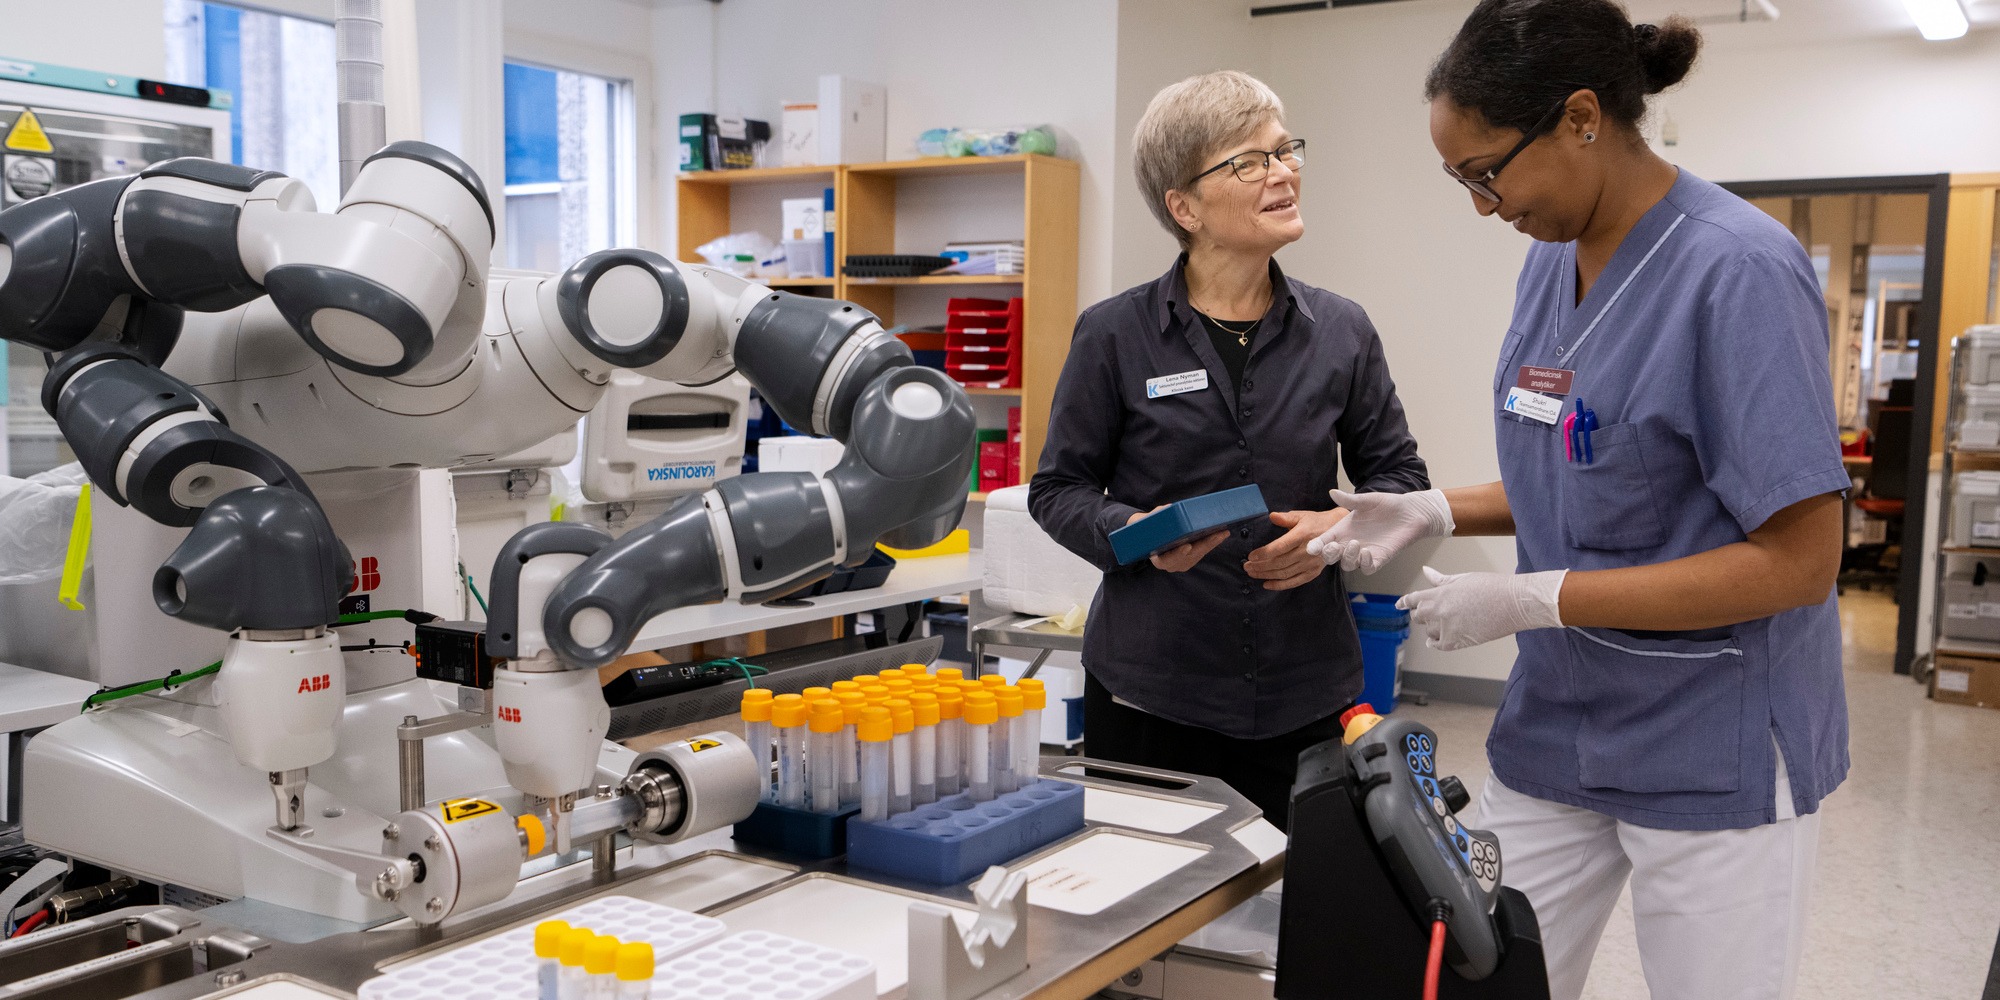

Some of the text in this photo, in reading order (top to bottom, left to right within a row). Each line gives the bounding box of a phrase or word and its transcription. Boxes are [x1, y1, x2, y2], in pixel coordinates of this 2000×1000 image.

[1529, 369, 1562, 379] Biomedicinsk
[1148, 384, 1159, 397] K
[1531, 381, 1555, 389] analytiker
[1506, 395, 1518, 410] K
[1532, 397, 1547, 405] Shukri
[647, 465, 716, 481] KAROLINSKA
[298, 674, 331, 694] ABB
[498, 705, 522, 723] ABB
